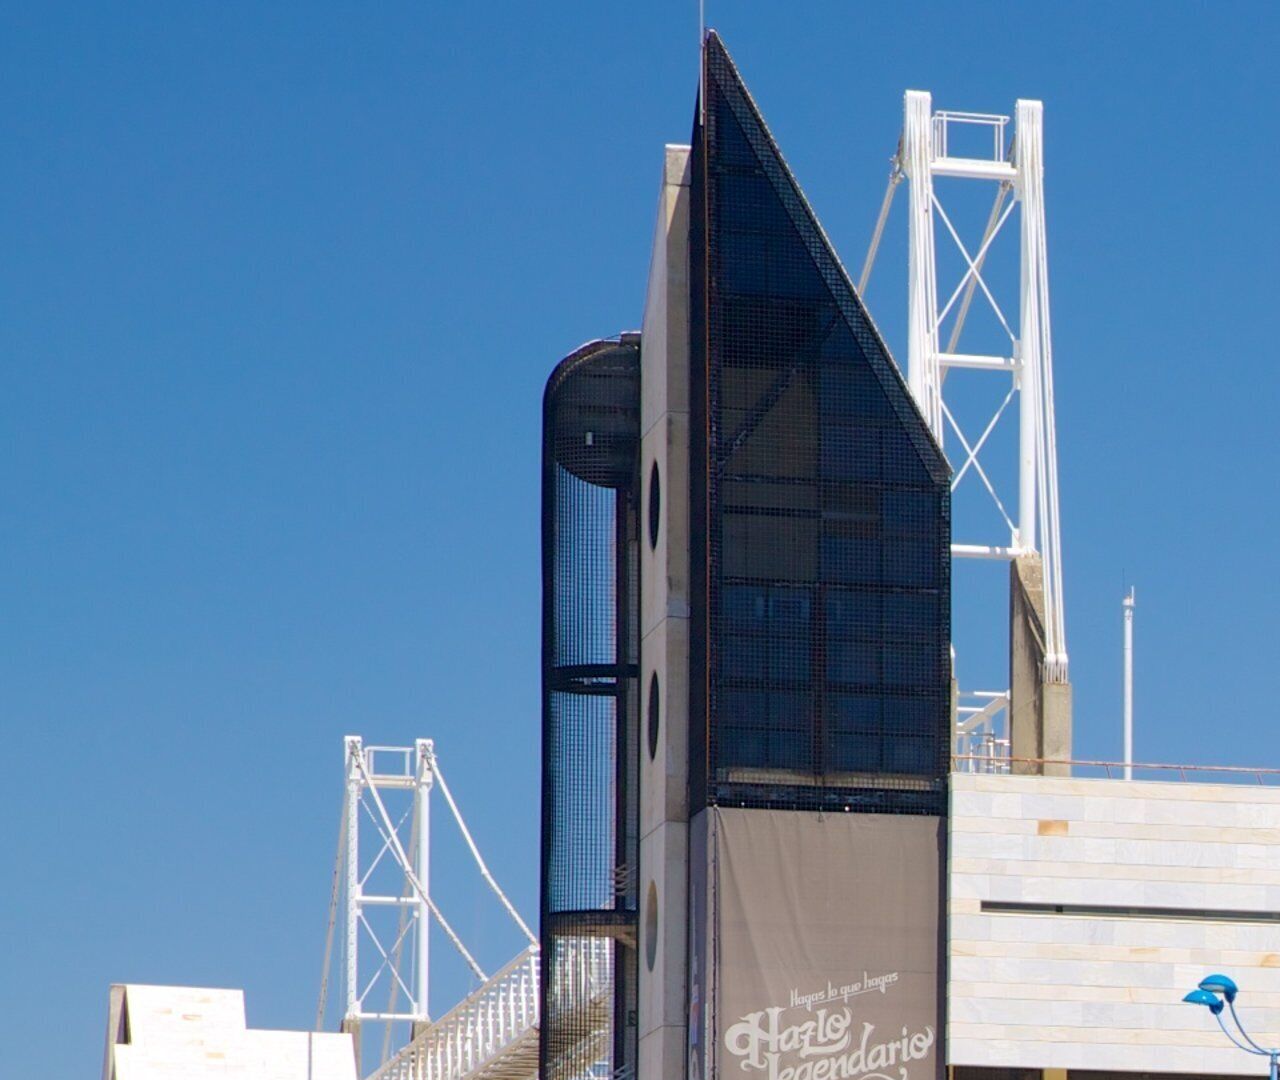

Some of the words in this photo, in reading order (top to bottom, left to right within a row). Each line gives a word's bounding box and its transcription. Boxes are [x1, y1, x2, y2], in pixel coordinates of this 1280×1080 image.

[840, 982, 862, 1004] que
[863, 970, 899, 994] hagas
[725, 1006, 852, 1071] Hazlo
